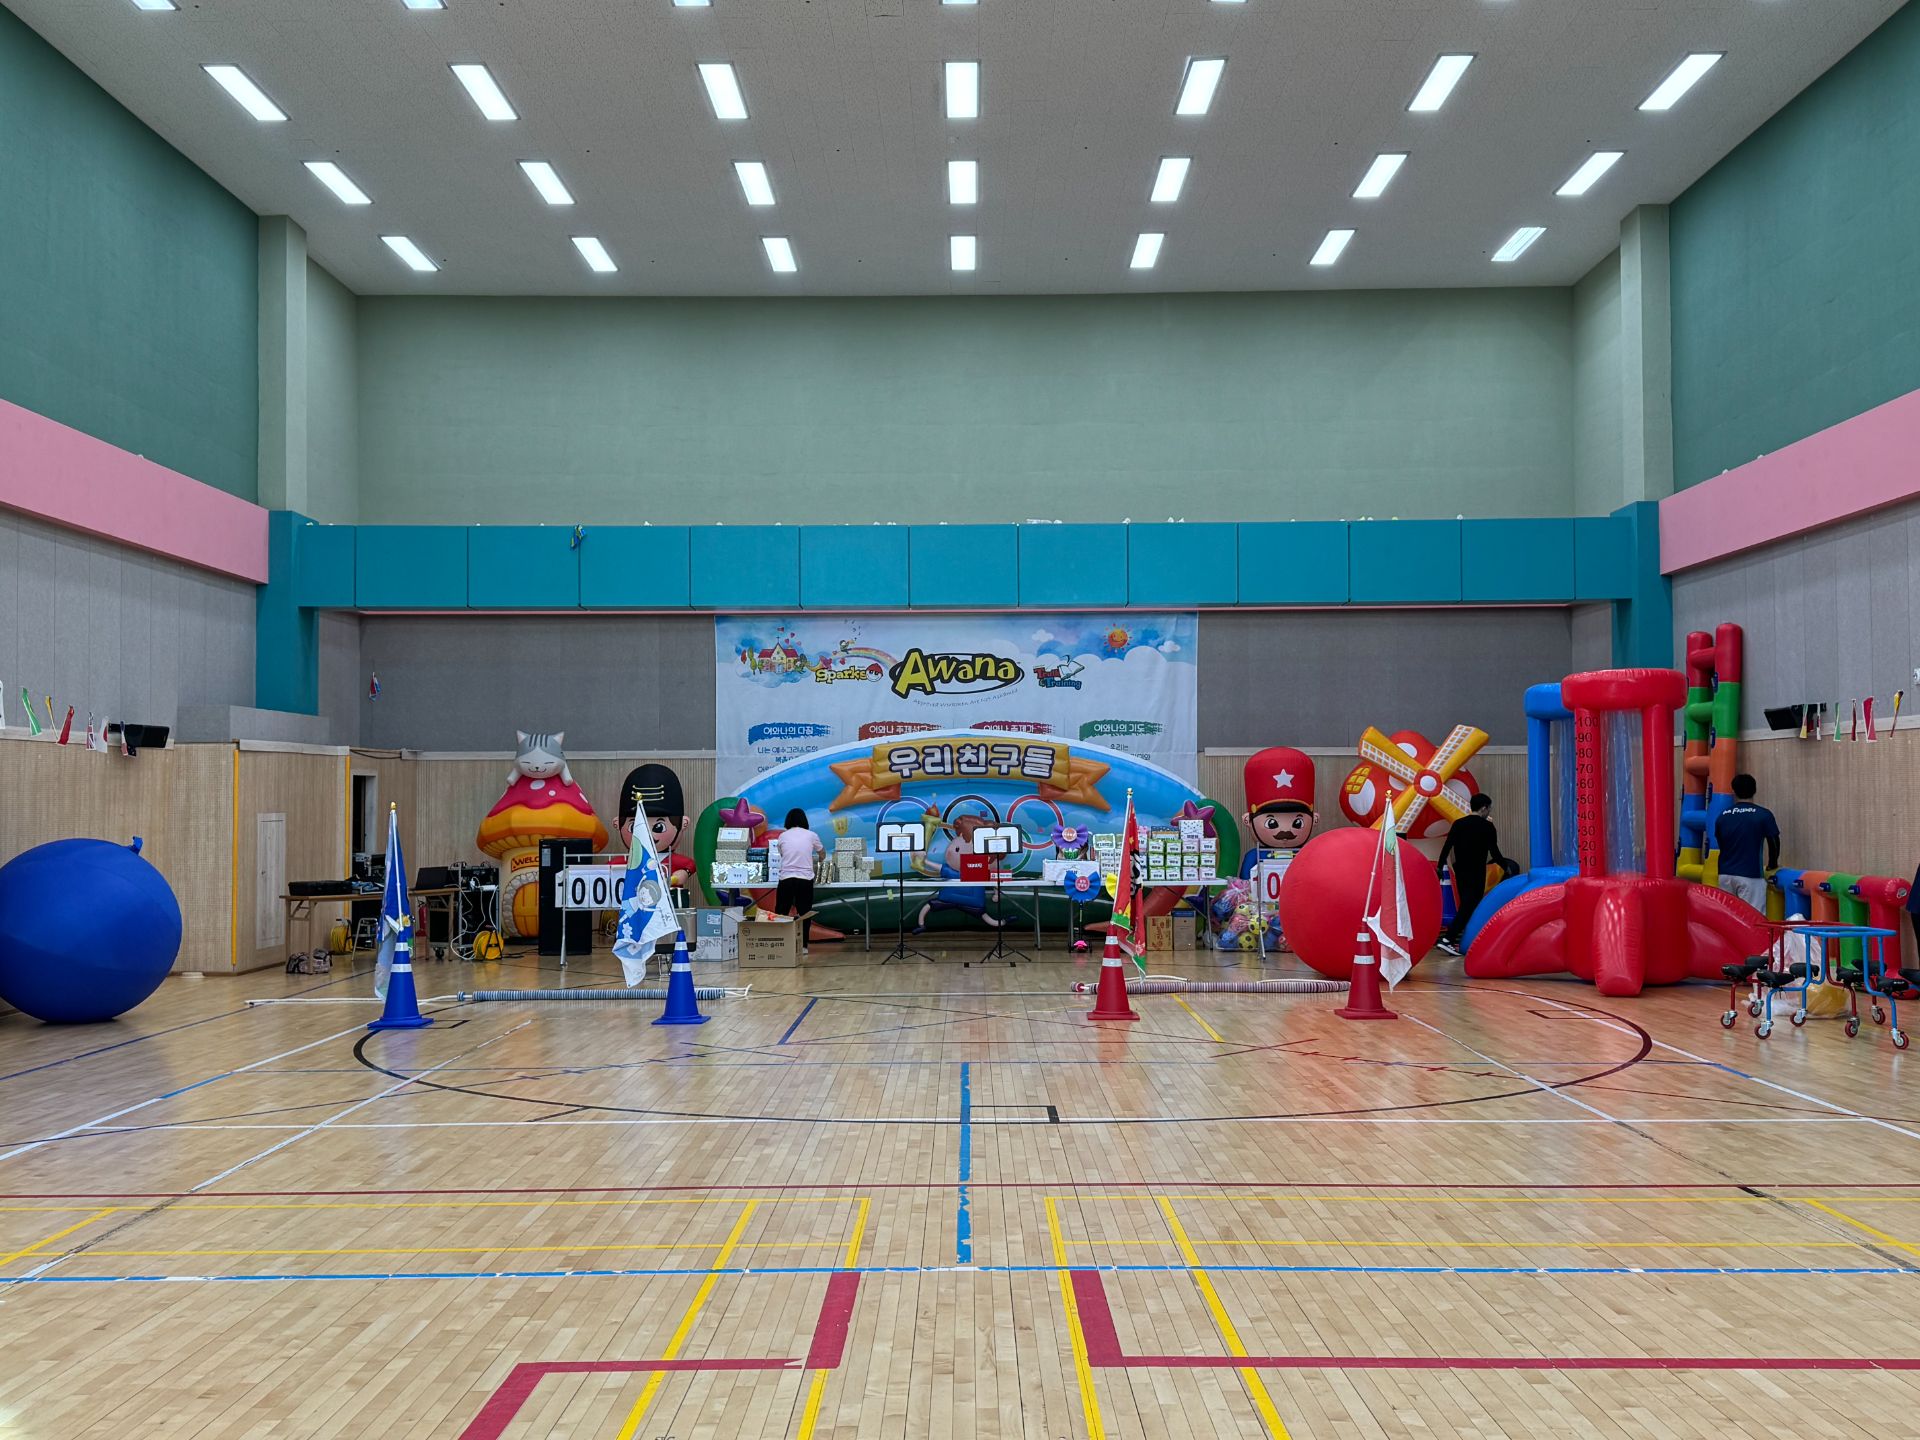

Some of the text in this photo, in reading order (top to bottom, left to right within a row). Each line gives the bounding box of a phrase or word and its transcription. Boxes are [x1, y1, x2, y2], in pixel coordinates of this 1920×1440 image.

[815, 666, 867, 684] Sparks
[892, 648, 1019, 699] Awana
[1045, 677, 1082, 690] Training
[1578, 716, 1599, 727] 100
[763, 726, 814, 735] 어와나의 다짐
[869, 725, 894, 735] 어와나
[1093, 723, 1145, 733] 어와나의 기도
[1578, 732, 1592, 743] 90
[1578, 748, 1593, 759] 80
[889, 742, 1056, 779] 우리친구들
[1579, 763, 1593, 774] 70
[1580, 779, 1594, 789] 60
[1580, 794, 1594, 804] 50
[1580, 810, 1595, 820] 40
[1582, 825, 1595, 836] 30
[1582, 841, 1596, 851] 20
[1583, 856, 1597, 867] 10
